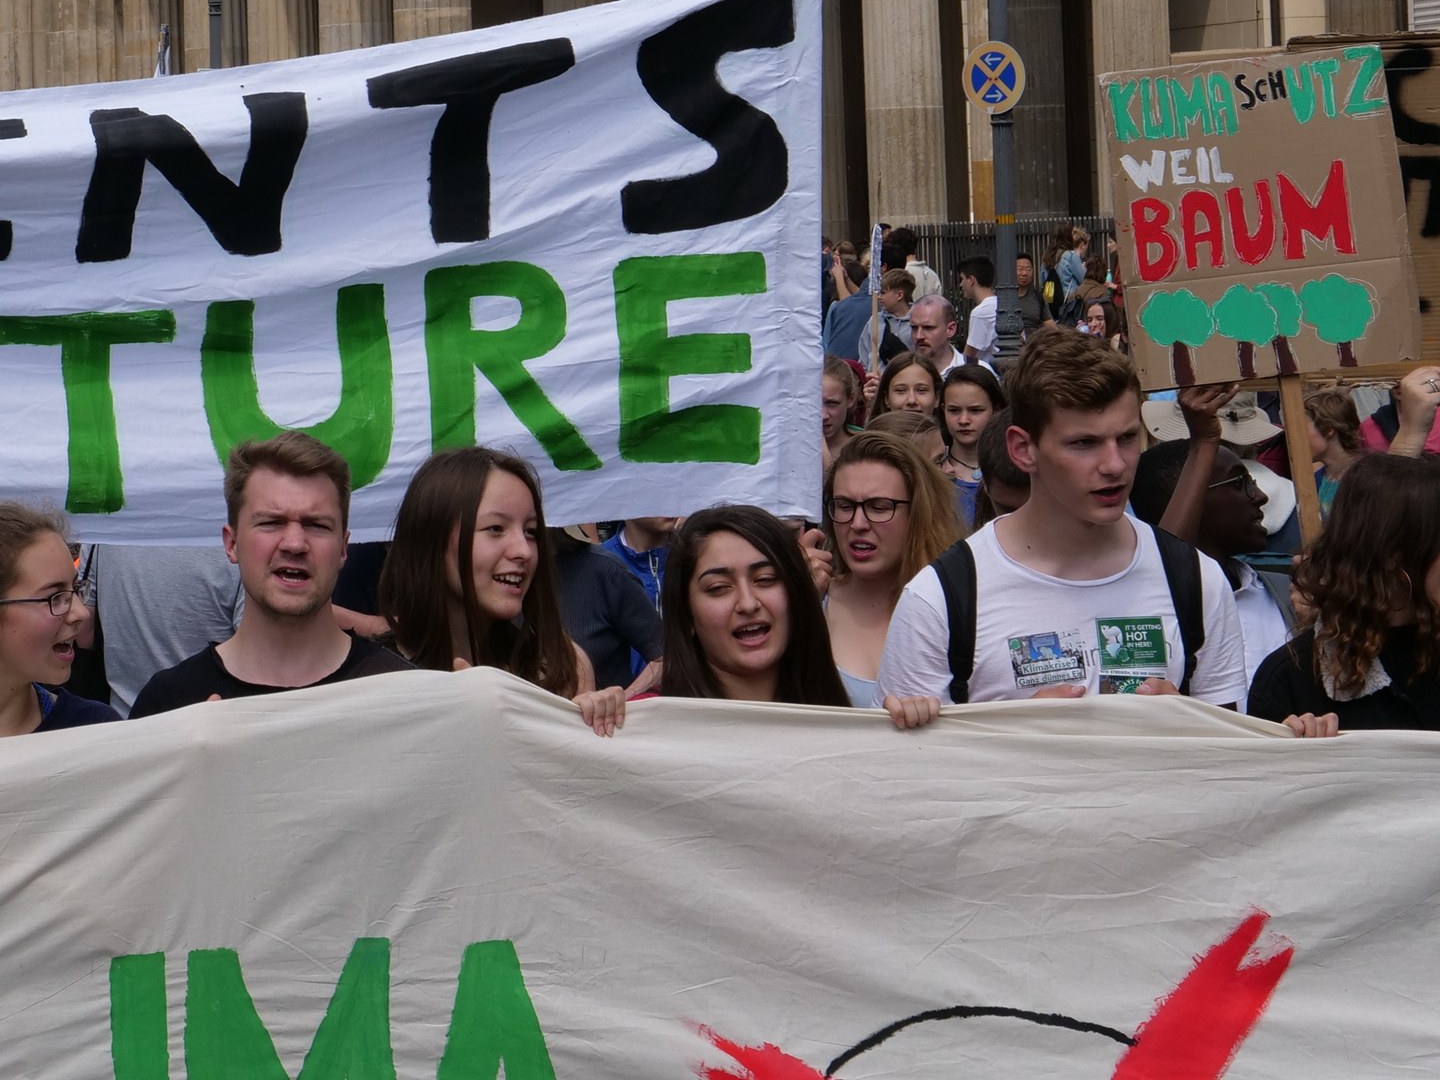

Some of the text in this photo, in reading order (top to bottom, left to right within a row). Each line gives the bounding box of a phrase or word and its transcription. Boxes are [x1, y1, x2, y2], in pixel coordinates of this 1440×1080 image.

[1119, 146, 1235, 193] WEIL
[1130, 158, 1358, 283] BAUM
[1136, 623, 1162, 631] GETTING
[1125, 631, 1148, 641] HOT
[1022, 657, 1077, 674] Klimakrise?
[1018, 677, 1040, 686] Ganz
[1041, 673, 1071, 683] dünnes
[1118, 678, 1137, 694] IDAYS
